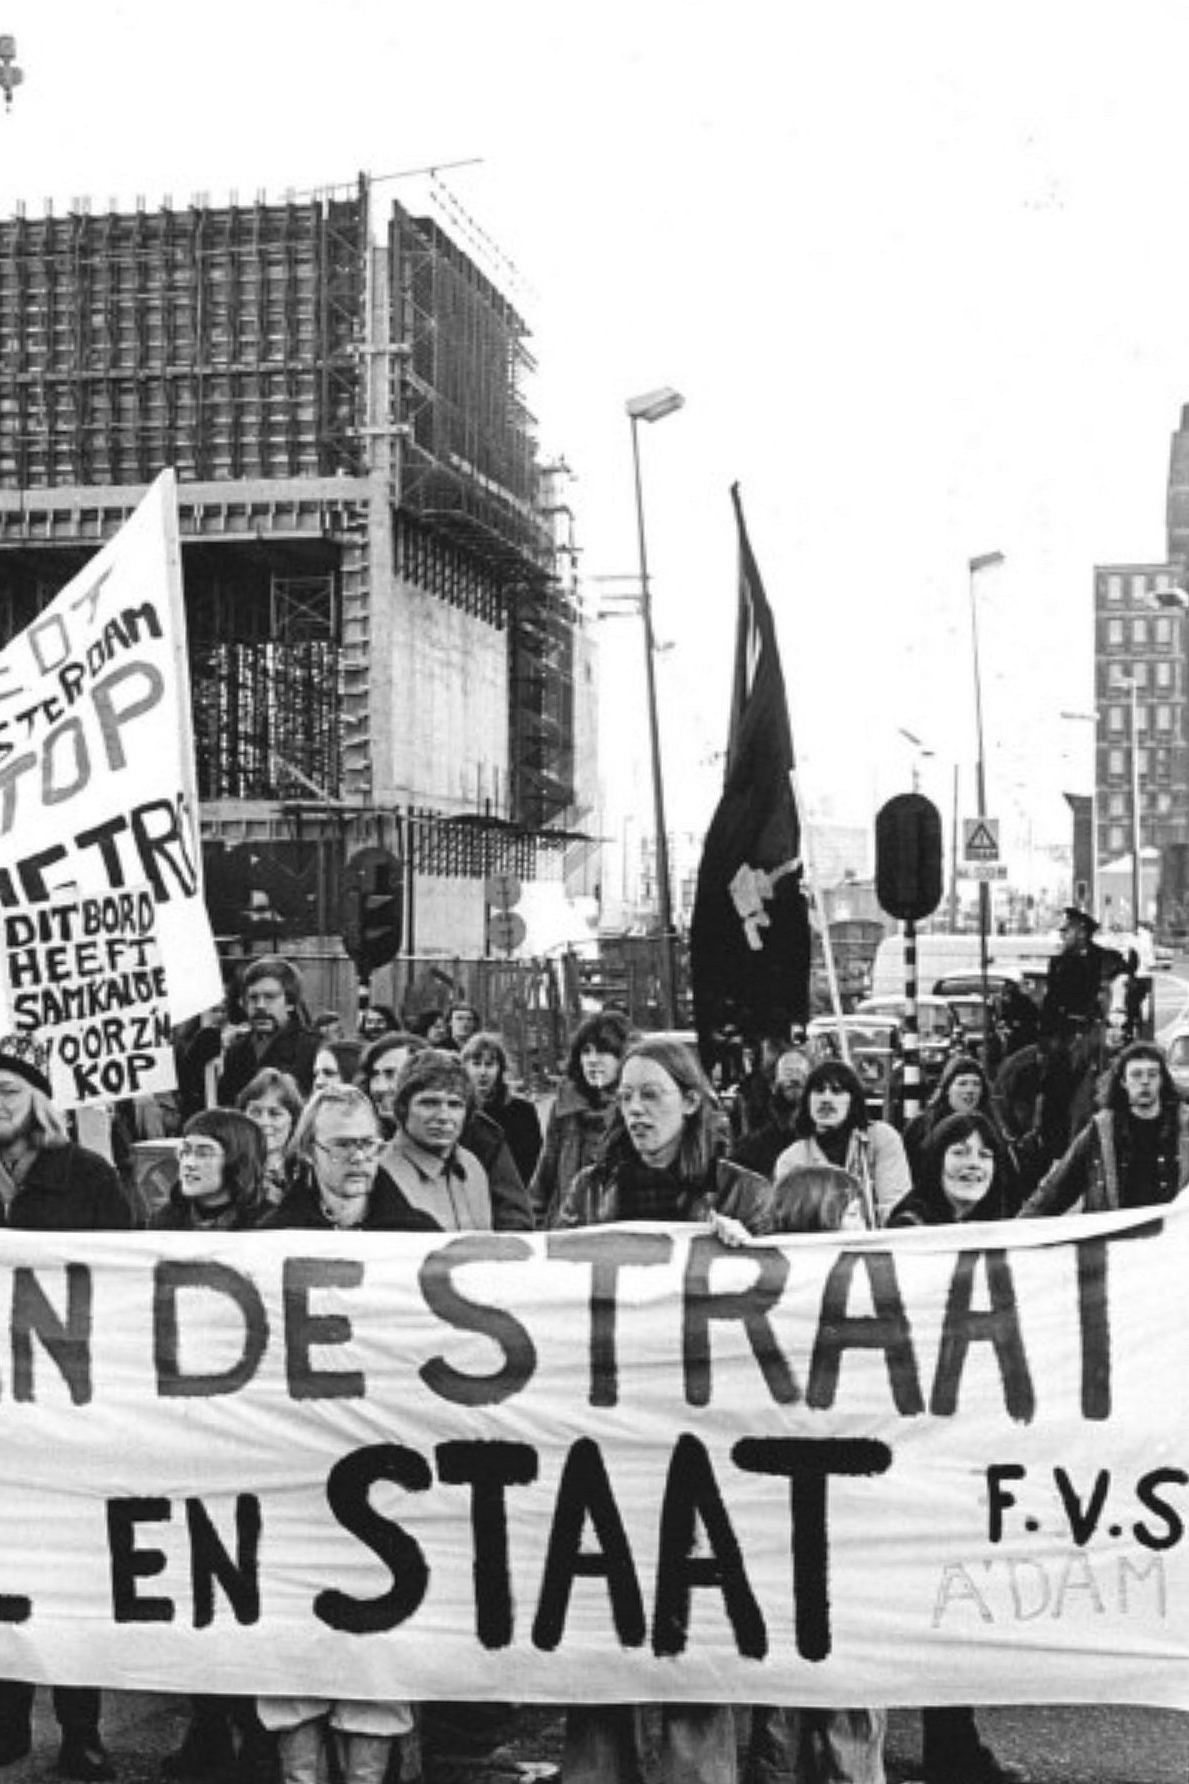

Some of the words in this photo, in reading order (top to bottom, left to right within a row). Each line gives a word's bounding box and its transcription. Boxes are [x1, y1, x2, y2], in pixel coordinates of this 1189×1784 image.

[4, 903, 79, 949] DIT
[81, 890, 155, 937] BORD
[8, 936, 156, 989] HEEFT
[45, 1017, 126, 1066] OOR
[72, 1053, 156, 1101] KOP
[152, 1256, 367, 1401] DE
[417, 1217, 1164, 1424] STRAAT
[107, 1493, 262, 1629] EN
[312, 1432, 893, 1663] STAAT
[931, 1552, 1167, 1629] A'DAM
